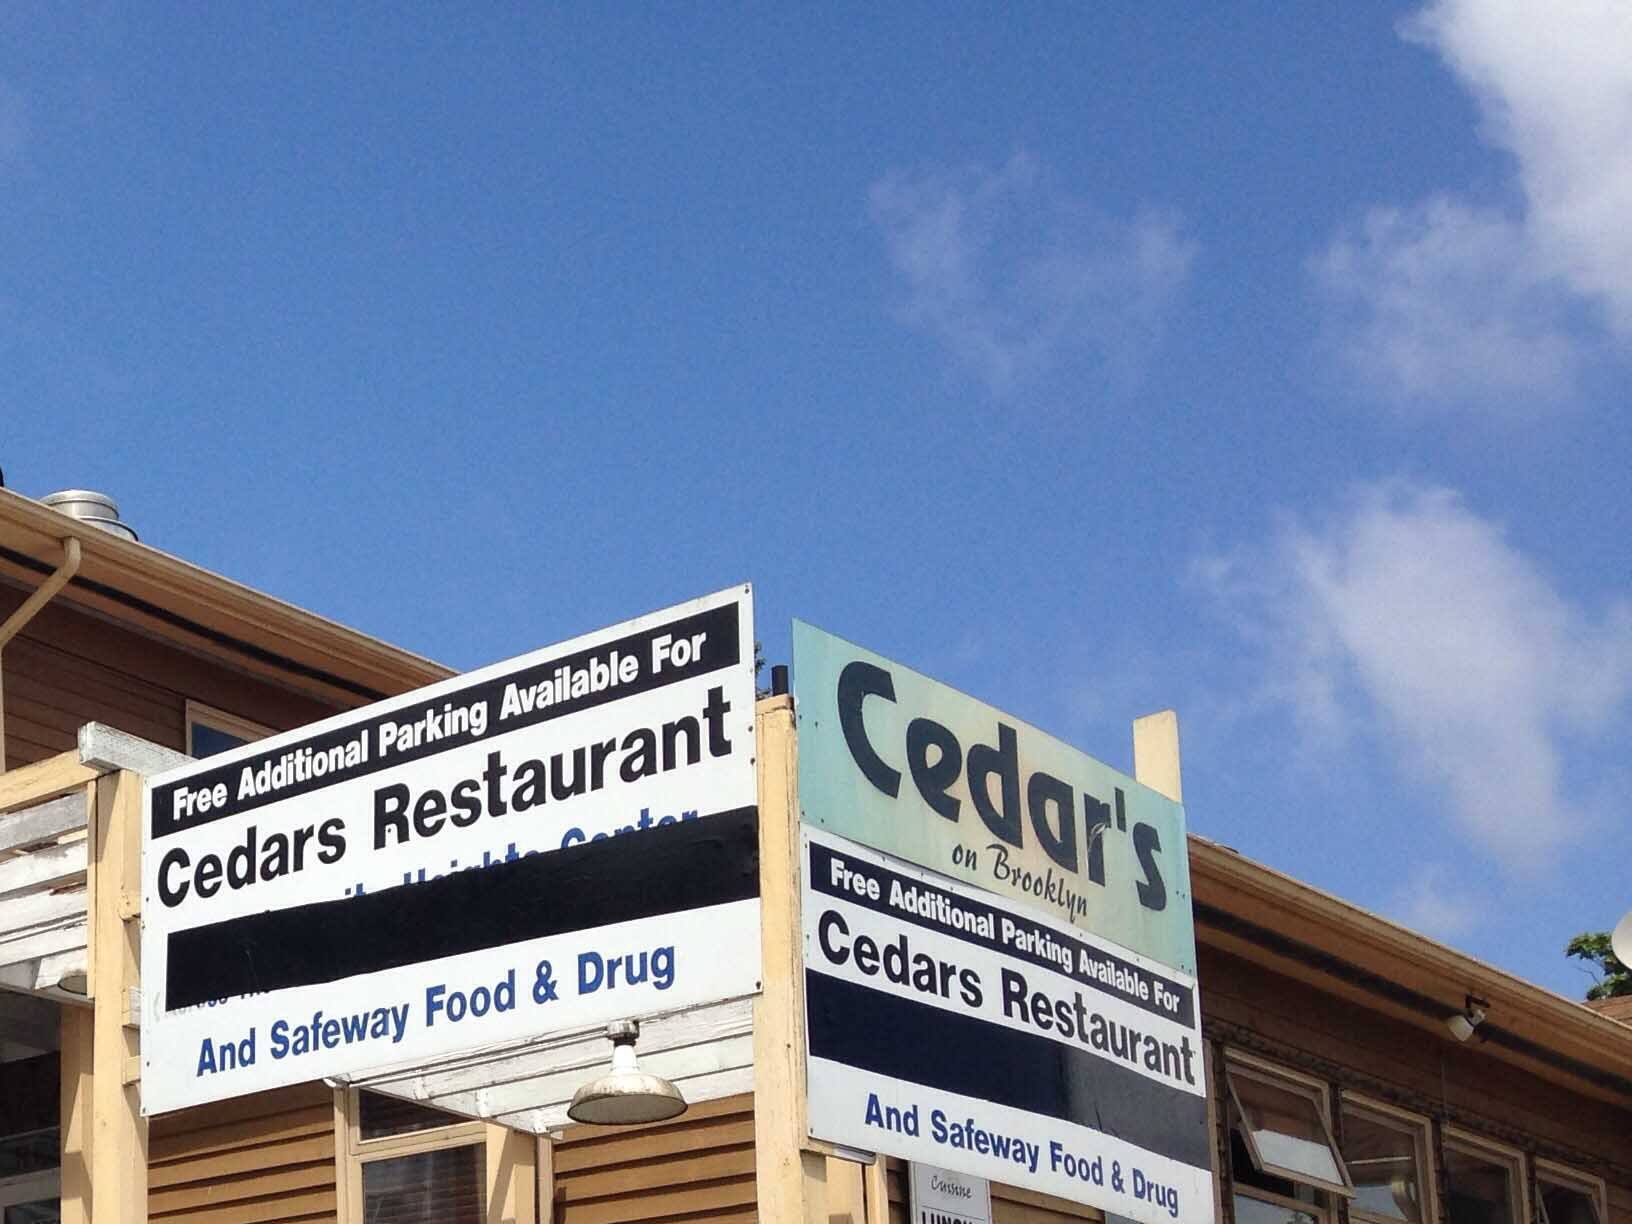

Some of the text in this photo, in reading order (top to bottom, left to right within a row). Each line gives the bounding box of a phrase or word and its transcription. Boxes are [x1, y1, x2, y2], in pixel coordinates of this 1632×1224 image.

[157, 816, 346, 908] Cedars
[372, 686, 732, 851] Restaurant
[172, 630, 708, 821] Free Additional Parking Available For
[837, 660, 1168, 912] Cedar's
[829, 859, 1181, 1013] Free Additional Parking Available For
[952, 842, 1089, 921] on Brooklyn
[196, 1027, 256, 1077] And
[270, 1003, 410, 1059] Safeway
[424, 969, 516, 1028] Food
[533, 960, 559, 1005] &
[576, 945, 677, 996] Drug
[818, 910, 1196, 1086] Cedars Restaurant
[864, 1093, 1180, 1218] And Safeway Food & Drug
